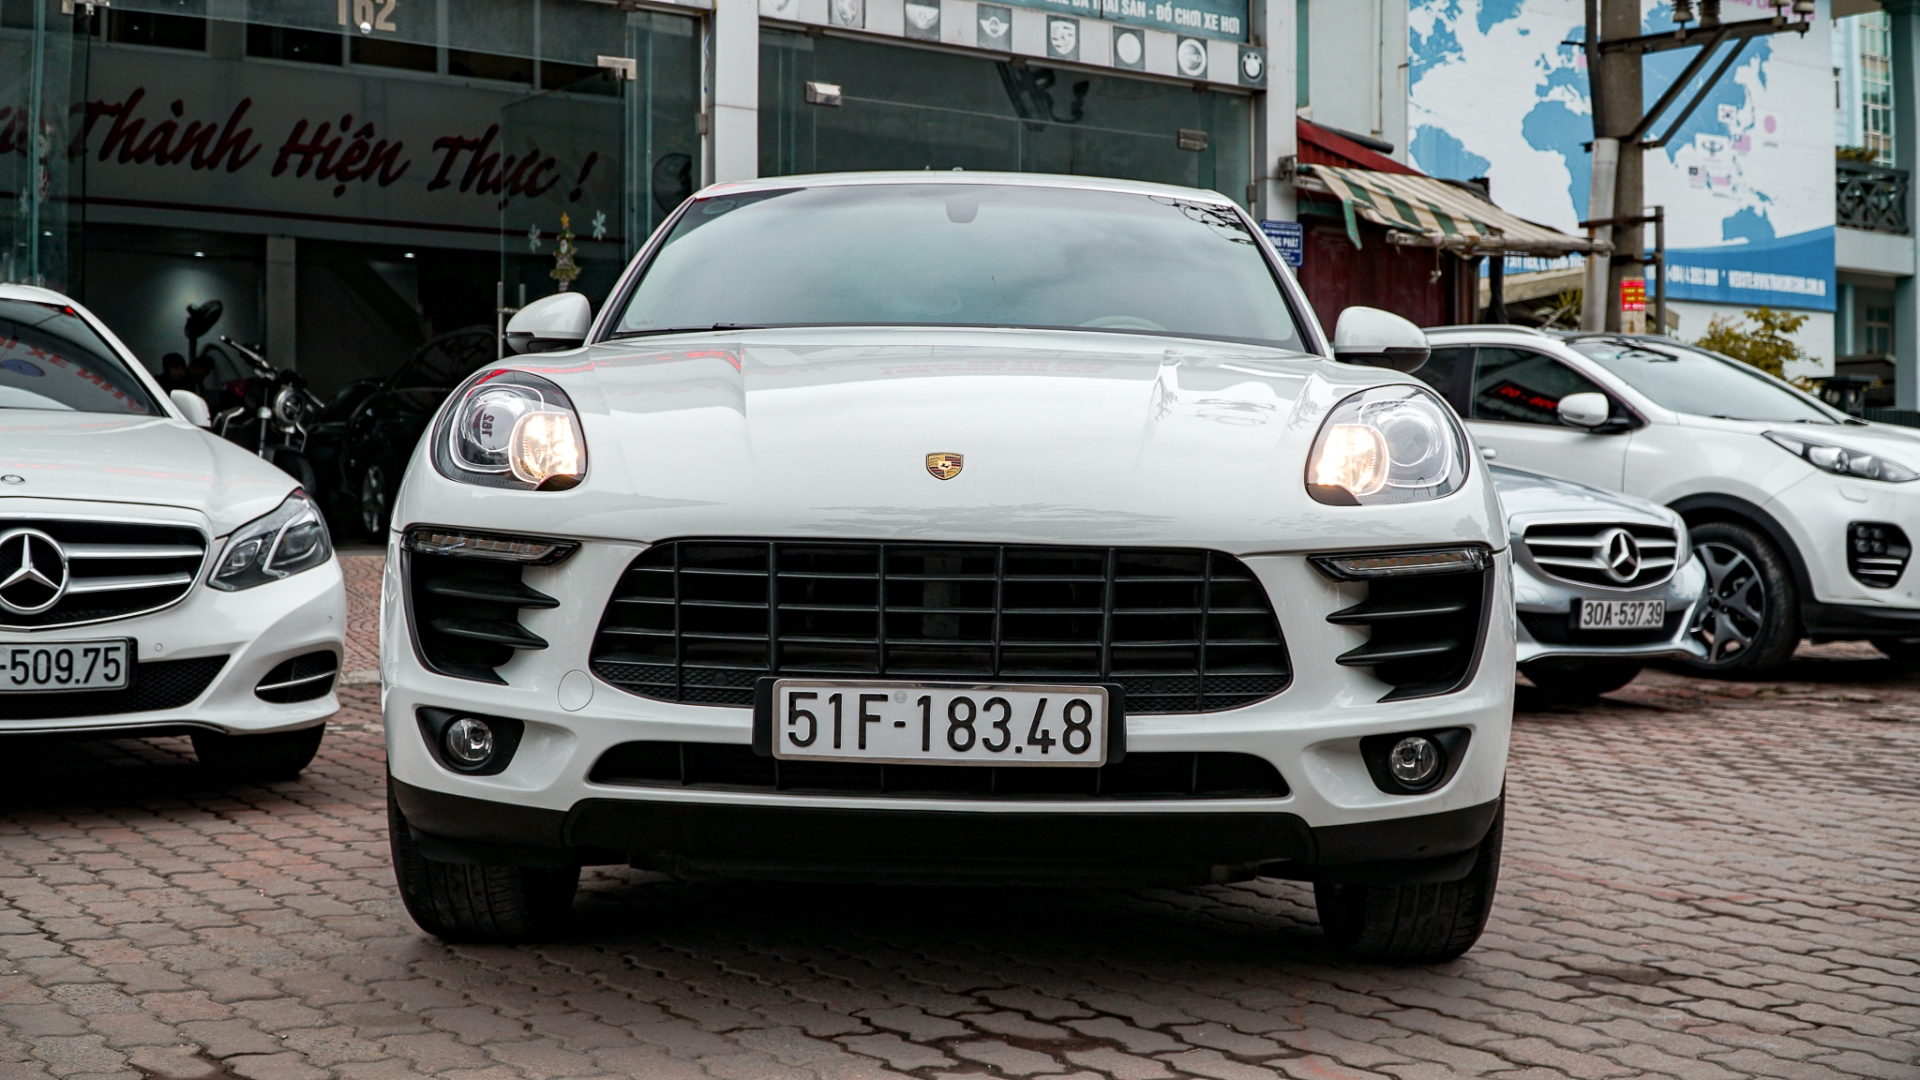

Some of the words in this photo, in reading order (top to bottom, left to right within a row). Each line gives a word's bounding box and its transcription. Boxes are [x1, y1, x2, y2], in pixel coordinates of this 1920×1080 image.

[1203, 12, 1219, 31] XE
[270, 113, 411, 198] Hiện
[1583, 602, 1664, 626] 30A-537.39
[788, 691, 1093, 755] 51F-183.48
